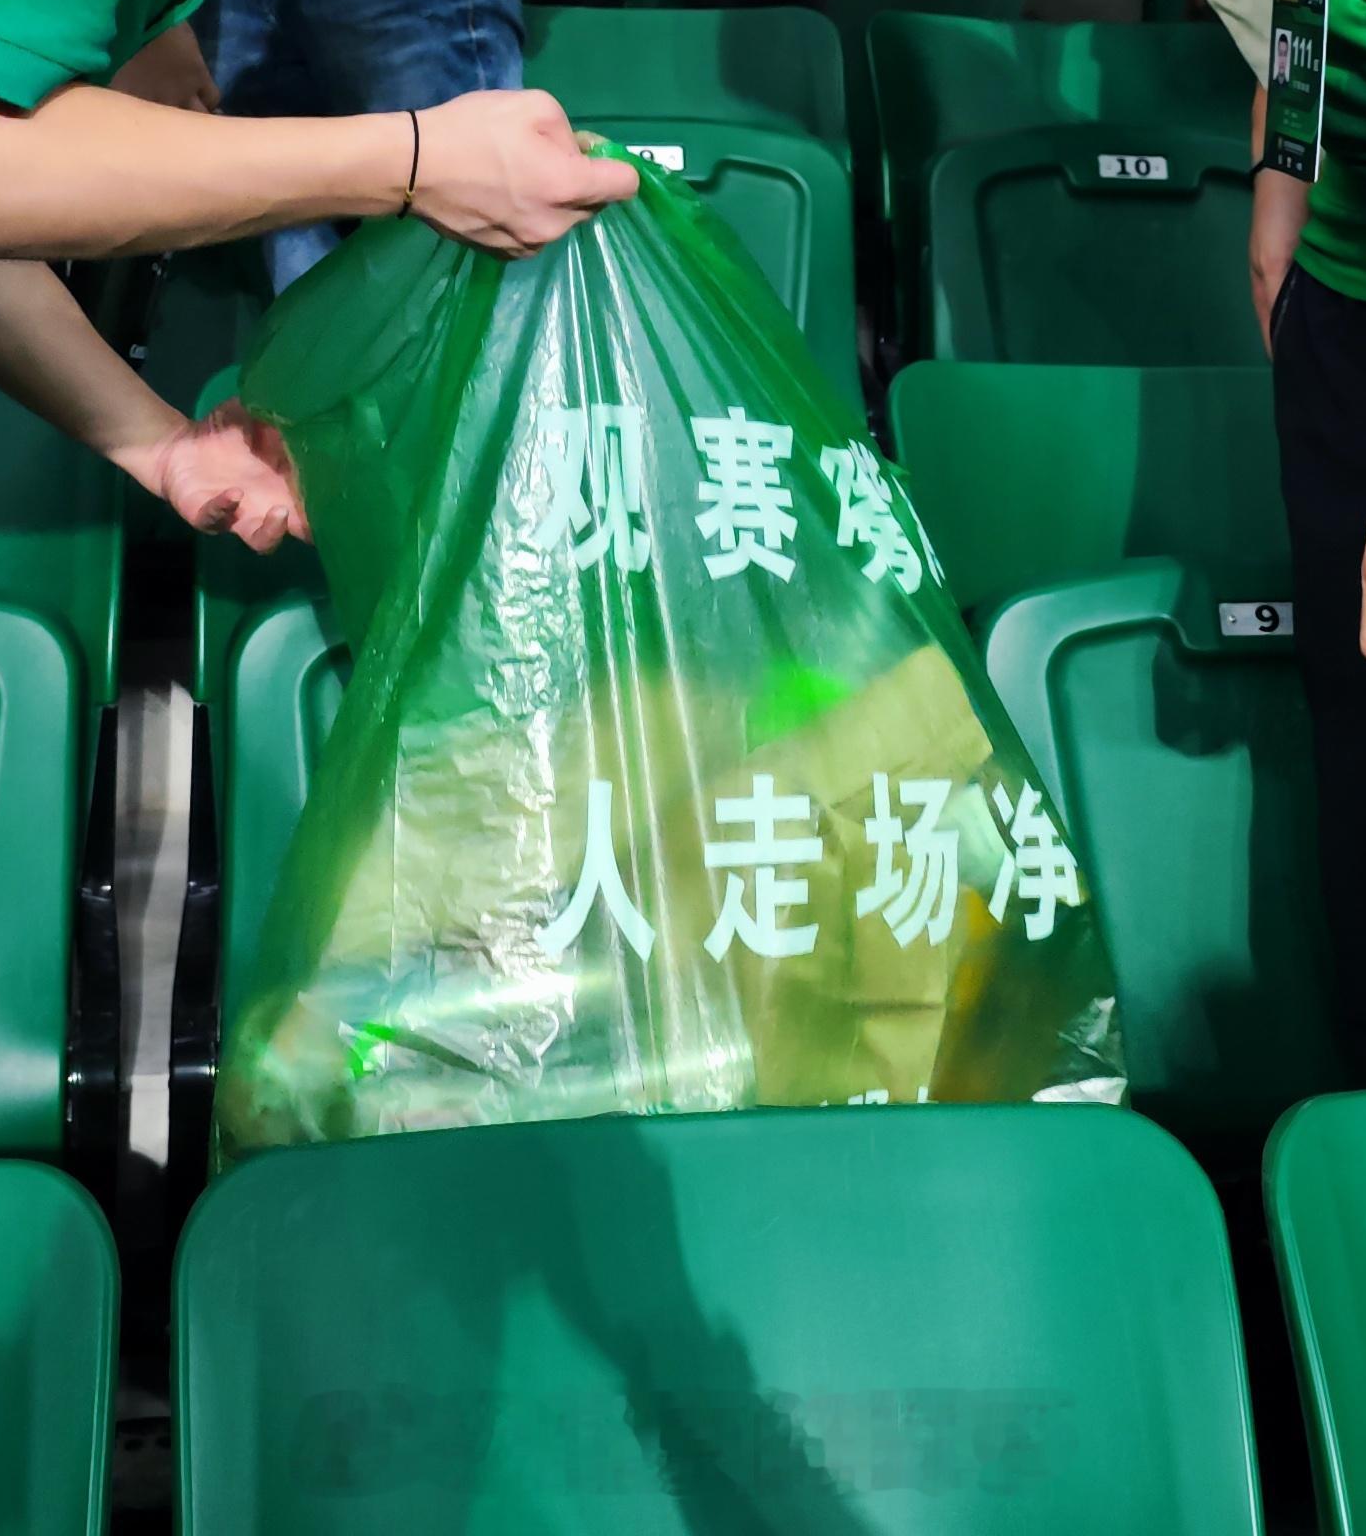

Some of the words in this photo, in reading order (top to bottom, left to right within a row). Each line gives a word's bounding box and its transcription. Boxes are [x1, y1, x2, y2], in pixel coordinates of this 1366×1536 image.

[1115, 156, 1153, 178] 10
[534, 404, 945, 595] 观赛嘴
[1254, 604, 1280, 634] 9
[535, 772, 1080, 963] 人走场净
